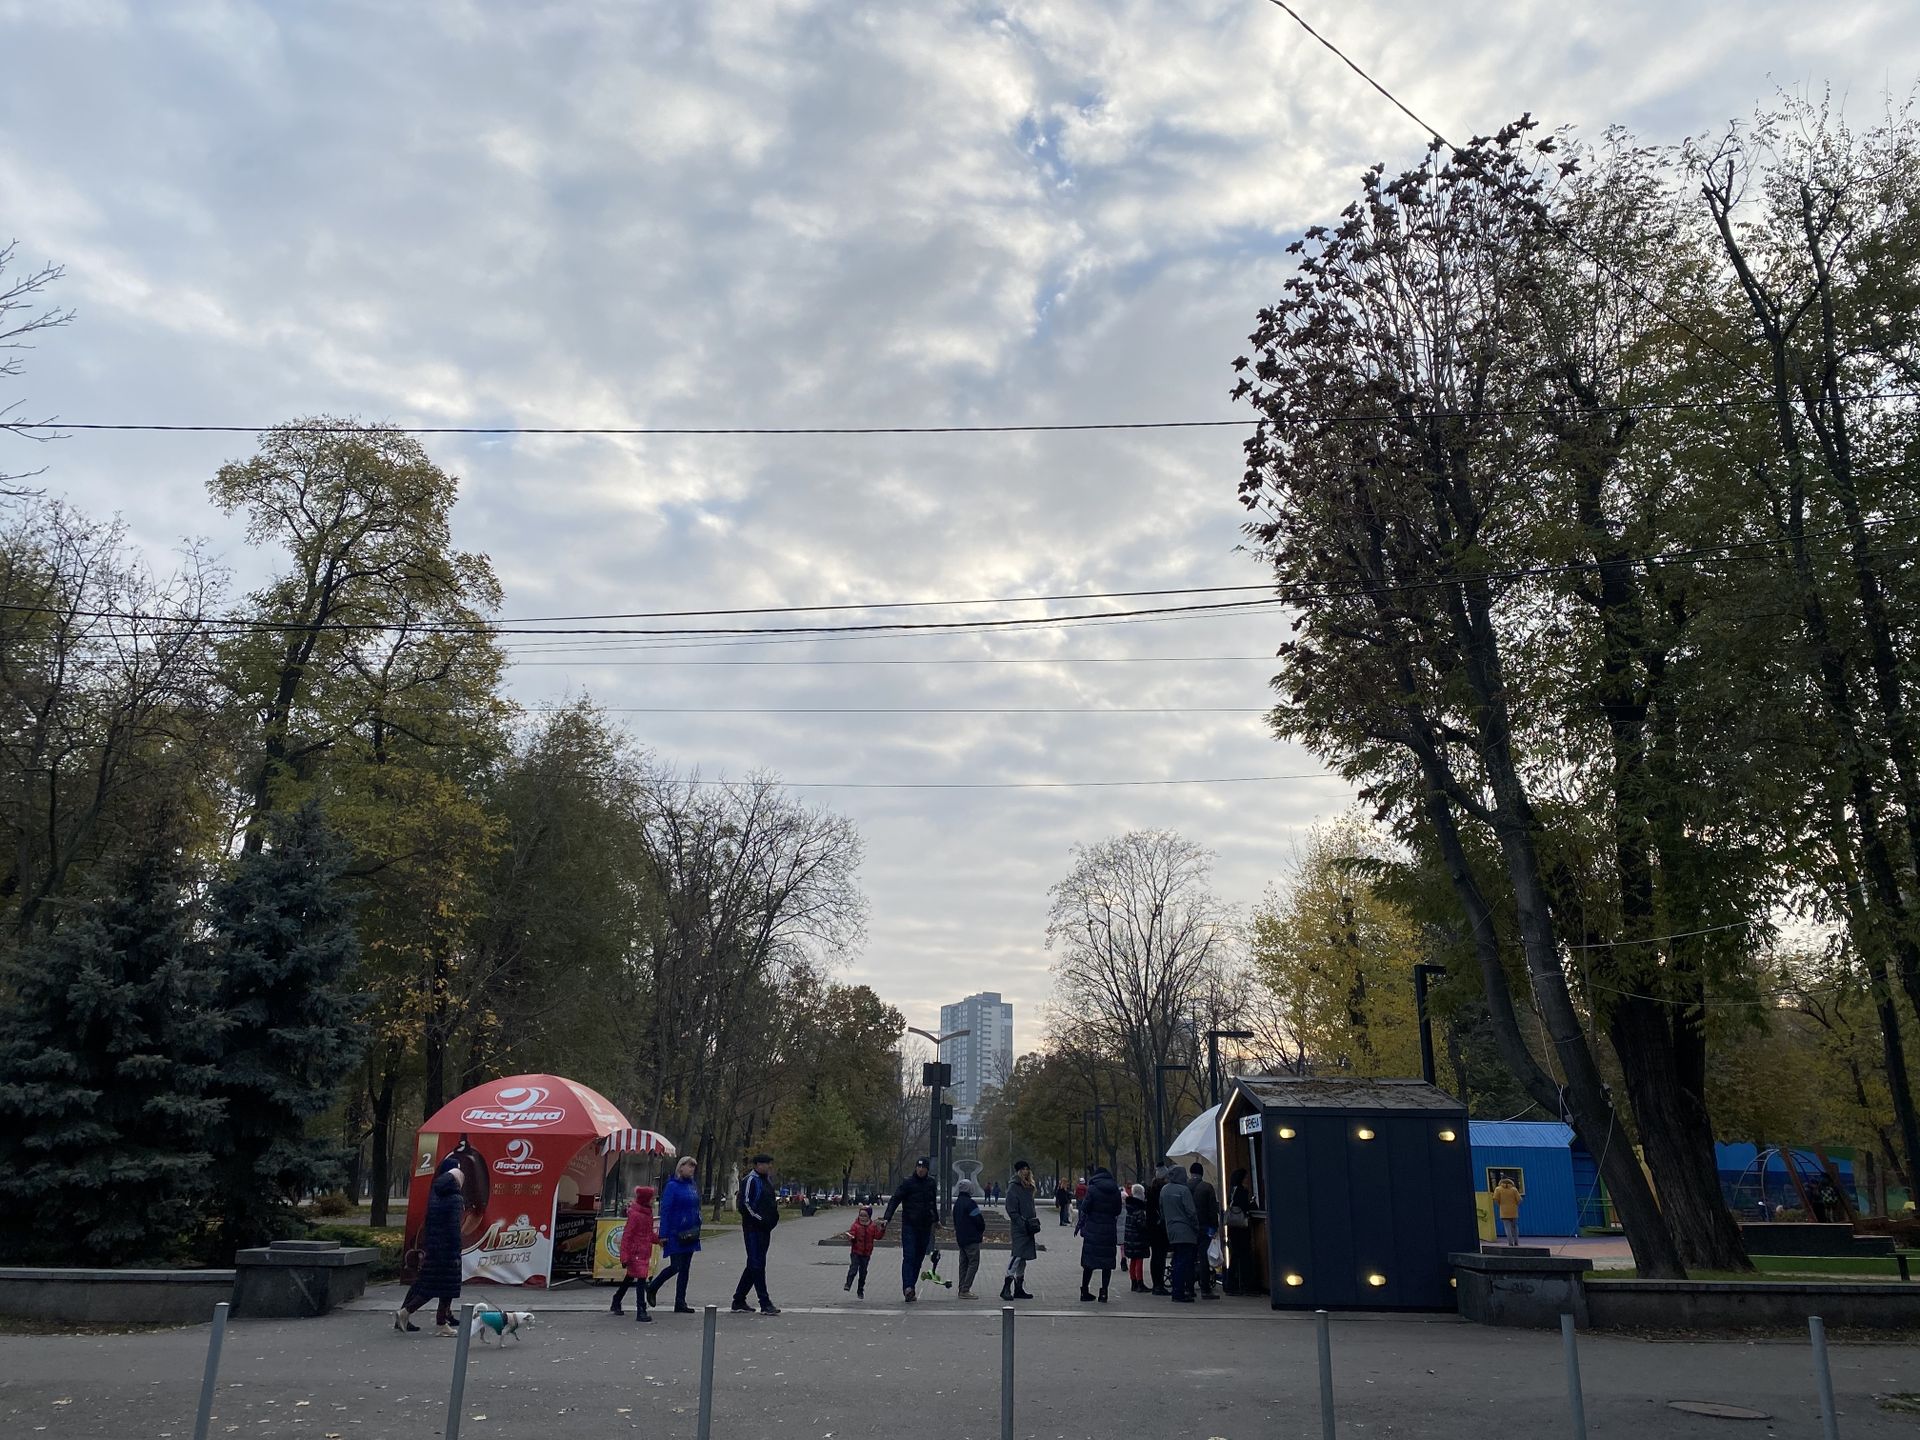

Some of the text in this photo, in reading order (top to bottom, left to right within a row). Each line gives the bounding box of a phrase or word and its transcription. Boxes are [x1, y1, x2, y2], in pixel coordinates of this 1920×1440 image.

[466, 1110, 562, 1122] Ласунка
[420, 1152, 432, 1169] 2
[495, 1161, 542, 1171] Ласунка
